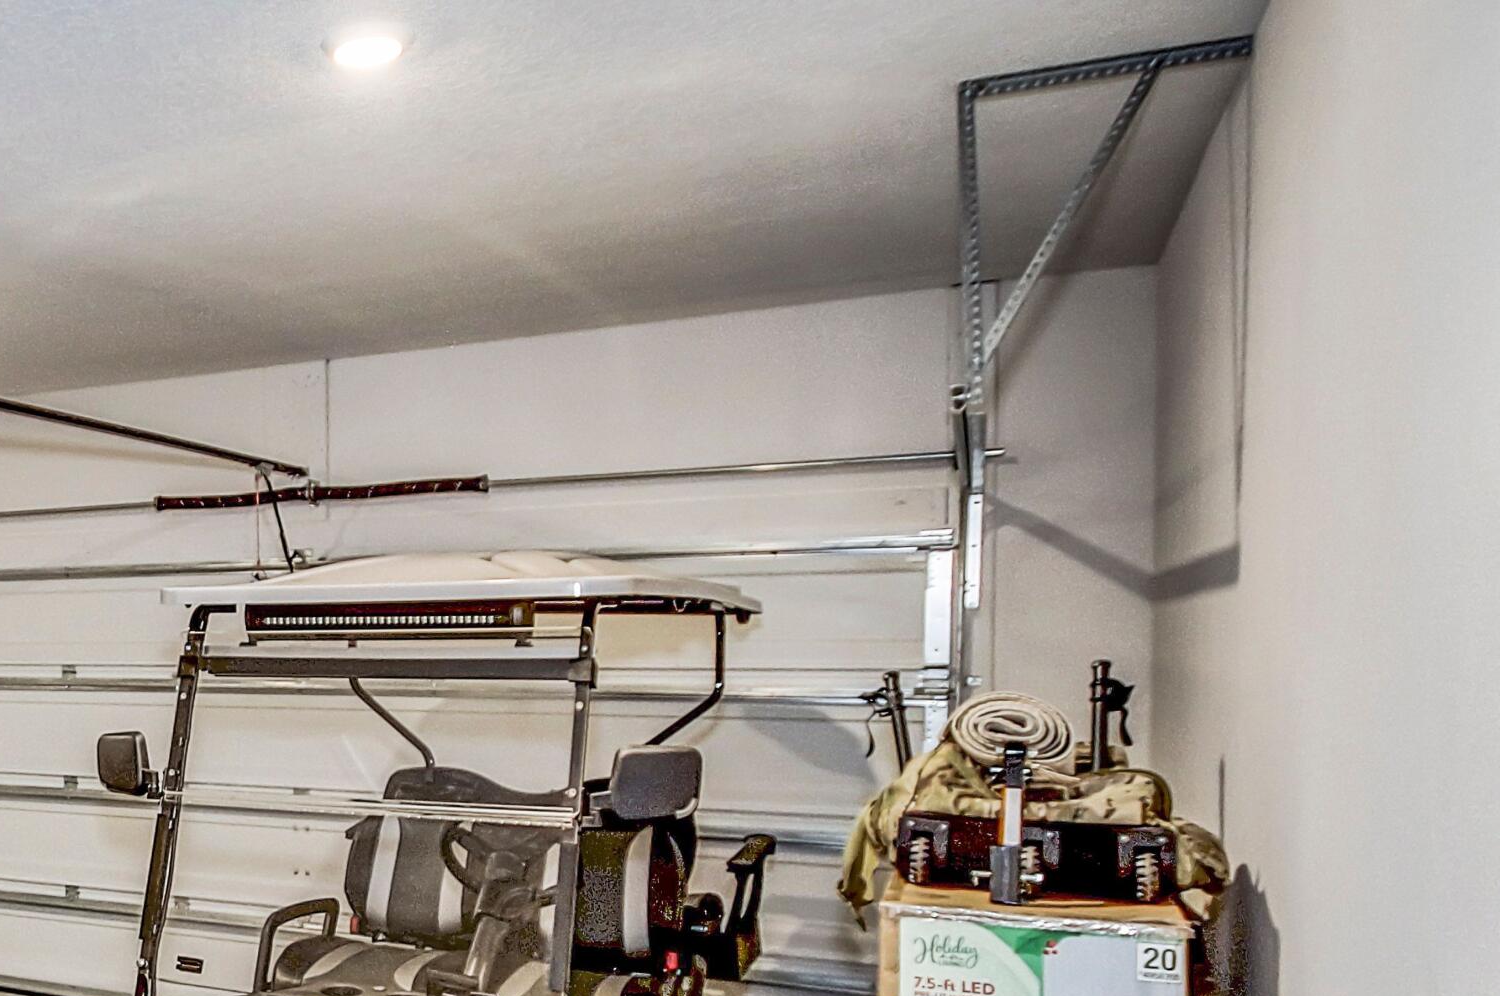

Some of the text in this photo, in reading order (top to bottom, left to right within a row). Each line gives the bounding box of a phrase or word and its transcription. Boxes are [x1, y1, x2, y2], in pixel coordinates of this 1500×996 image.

[913, 933, 979, 969] Holiday
[1143, 947, 1177, 971] 20
[914, 976, 996, 996] 7.5-ft LED
